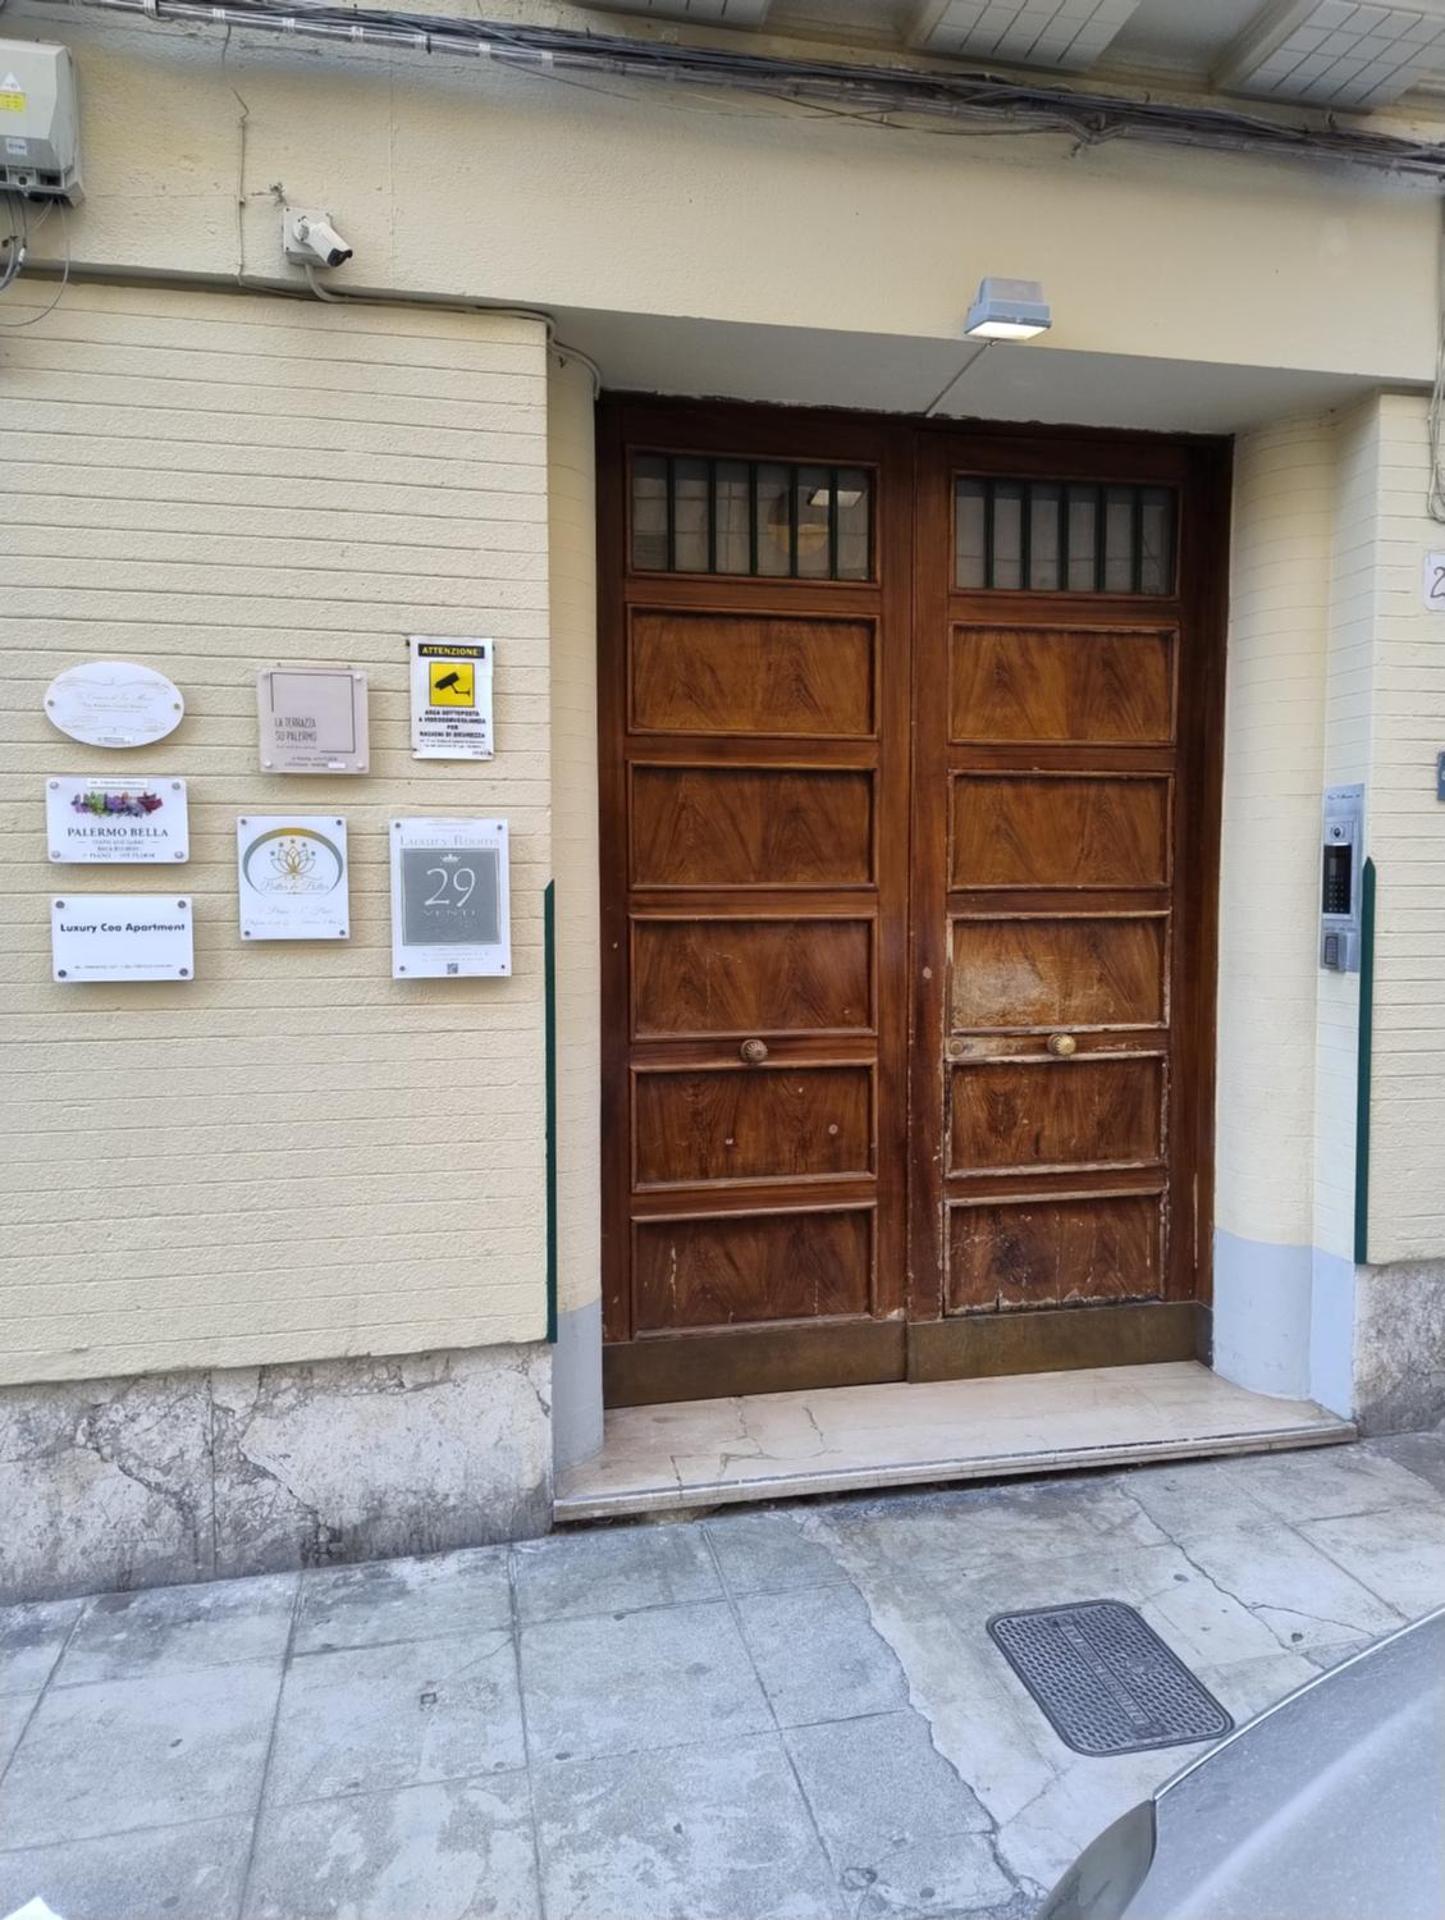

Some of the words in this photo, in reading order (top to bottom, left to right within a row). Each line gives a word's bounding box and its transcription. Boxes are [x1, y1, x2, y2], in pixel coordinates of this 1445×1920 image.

[67, 827, 127, 837] PALERMO
[130, 827, 169, 837] BELLA
[424, 867, 476, 908] 29
[60, 923, 97, 934] Luxury
[125, 923, 185, 933] Apartment
